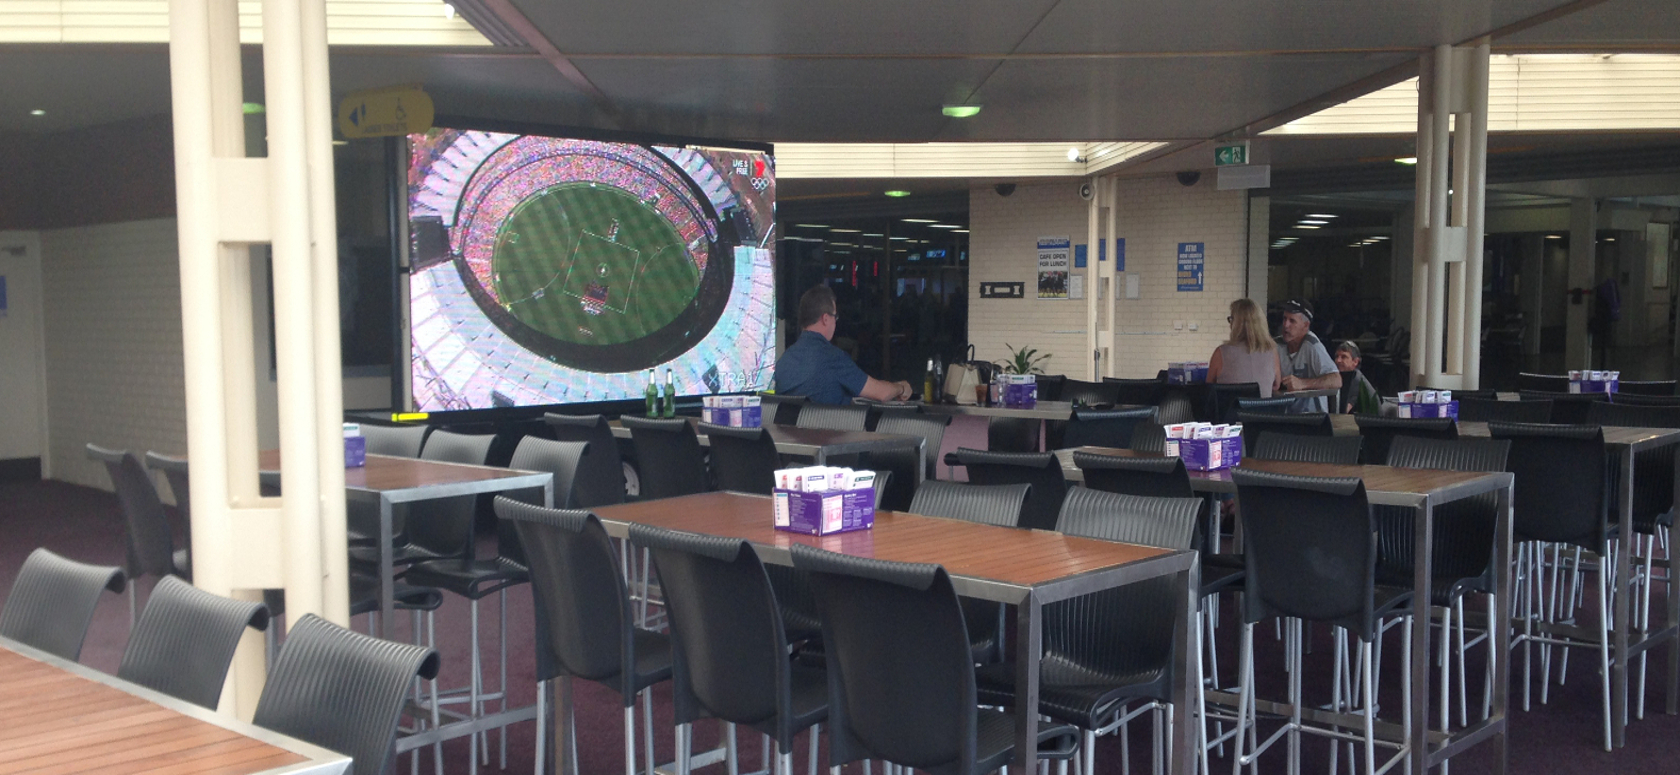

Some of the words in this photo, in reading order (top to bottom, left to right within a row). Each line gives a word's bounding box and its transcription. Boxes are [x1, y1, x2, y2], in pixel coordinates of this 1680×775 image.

[733, 159, 743, 167] LIVE
[736, 167, 748, 175] FREE
[1185, 244, 1197, 252] ATM
